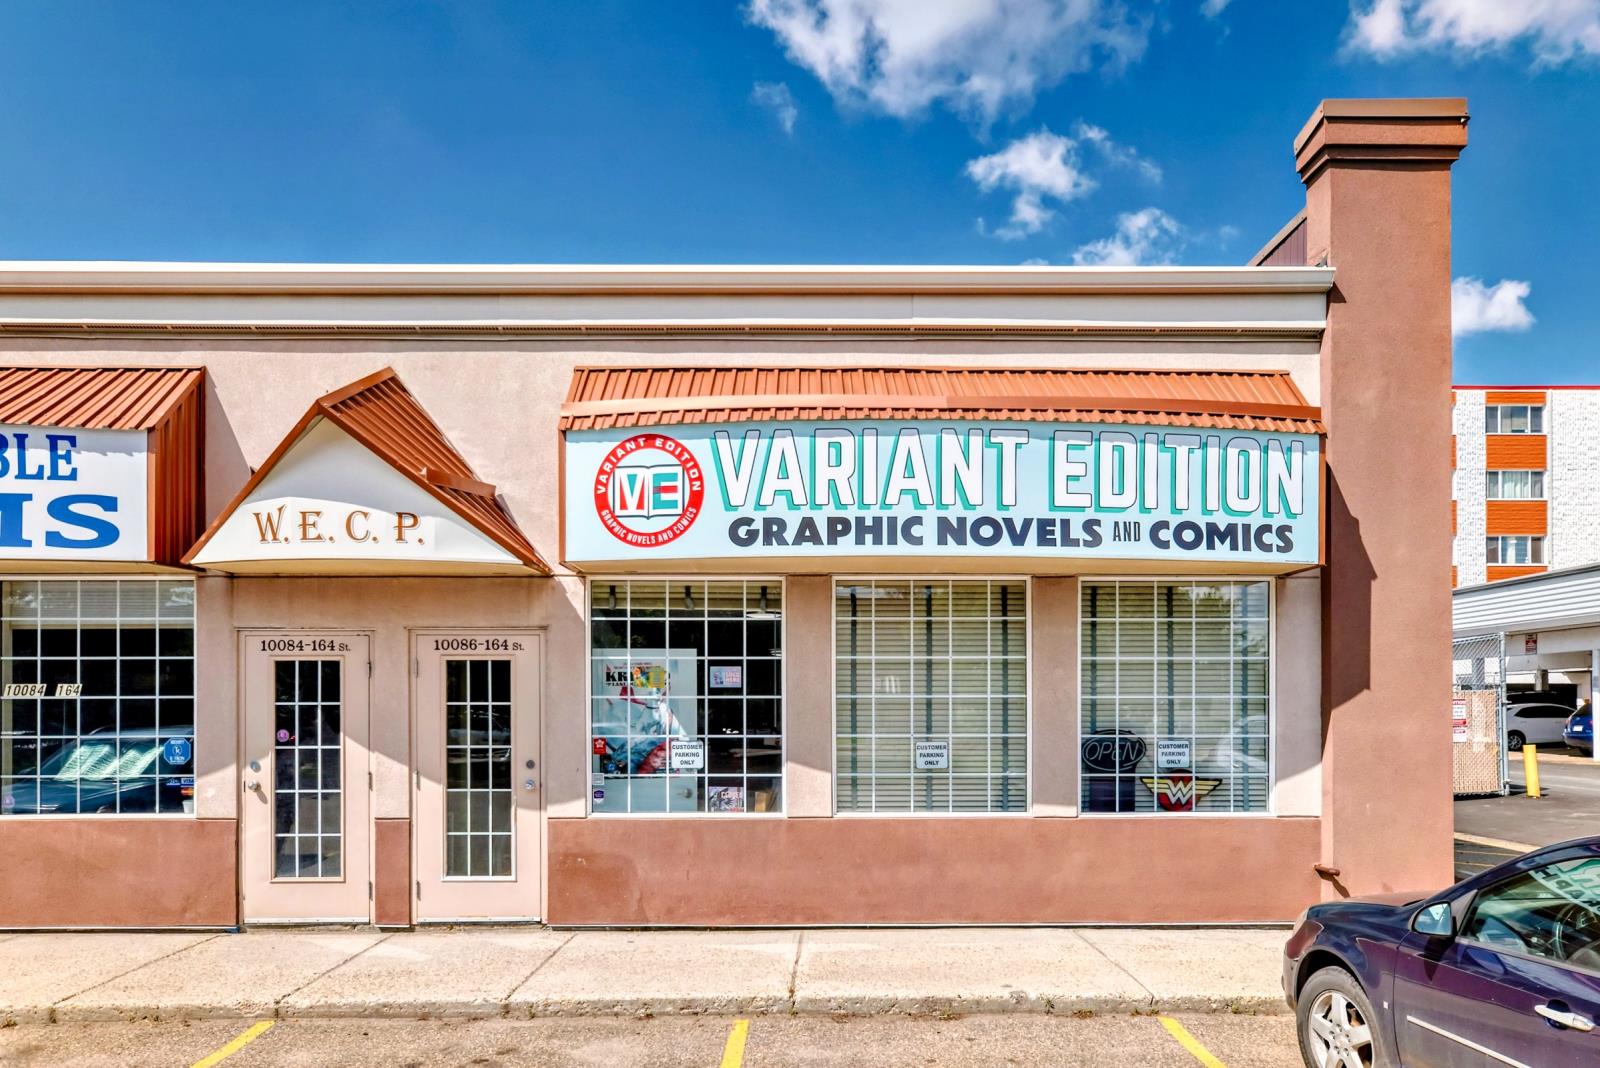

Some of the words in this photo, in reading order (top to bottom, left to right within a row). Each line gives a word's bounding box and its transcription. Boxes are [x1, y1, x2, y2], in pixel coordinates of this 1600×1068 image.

[597, 437, 646, 494] VARIANT
[655, 437, 701, 491] EDITION
[709, 428, 1029, 512] VARIANT
[1048, 429, 1304, 519] EDITION
[626, 532, 656, 545] NOVELS
[658, 532, 674, 543] AND
[673, 506, 697, 534] COMICS
[728, 515, 924, 547] GRAPHIC
[936, 516, 1103, 548] NOVELS
[1112, 520, 1141, 542] AND
[1149, 520, 1294, 553] COMICS
[260, 639, 336, 652] 10084-164
[338, 644, 351, 652] St.
[433, 638, 509, 651] 10086-164
[6, 684, 45, 697] 10084
[59, 684, 81, 697] 164
[1084, 741, 1140, 761] OPEN
